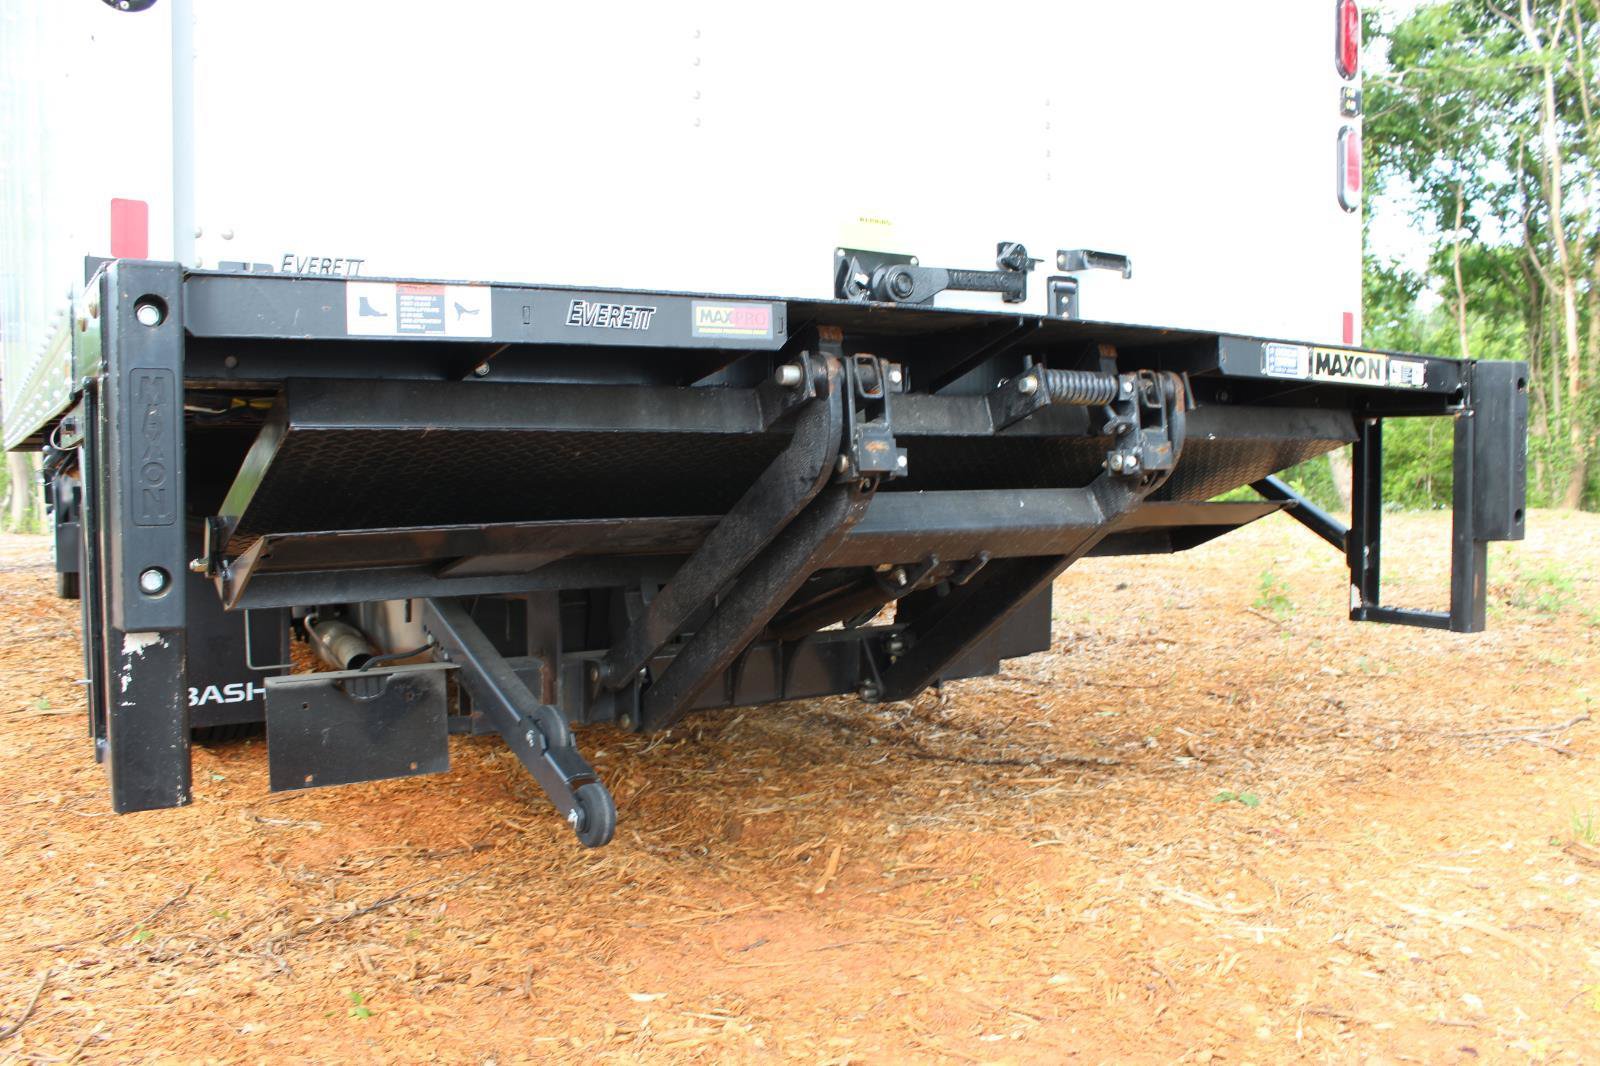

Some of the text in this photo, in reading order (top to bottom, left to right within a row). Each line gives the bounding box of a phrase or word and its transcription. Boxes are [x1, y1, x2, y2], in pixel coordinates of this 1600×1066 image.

[281, 253, 365, 277] EVERETT
[565, 299, 657, 331] EVERETT
[700, 308, 767, 326] MAXPRO
[1315, 352, 1381, 380] MAXON
